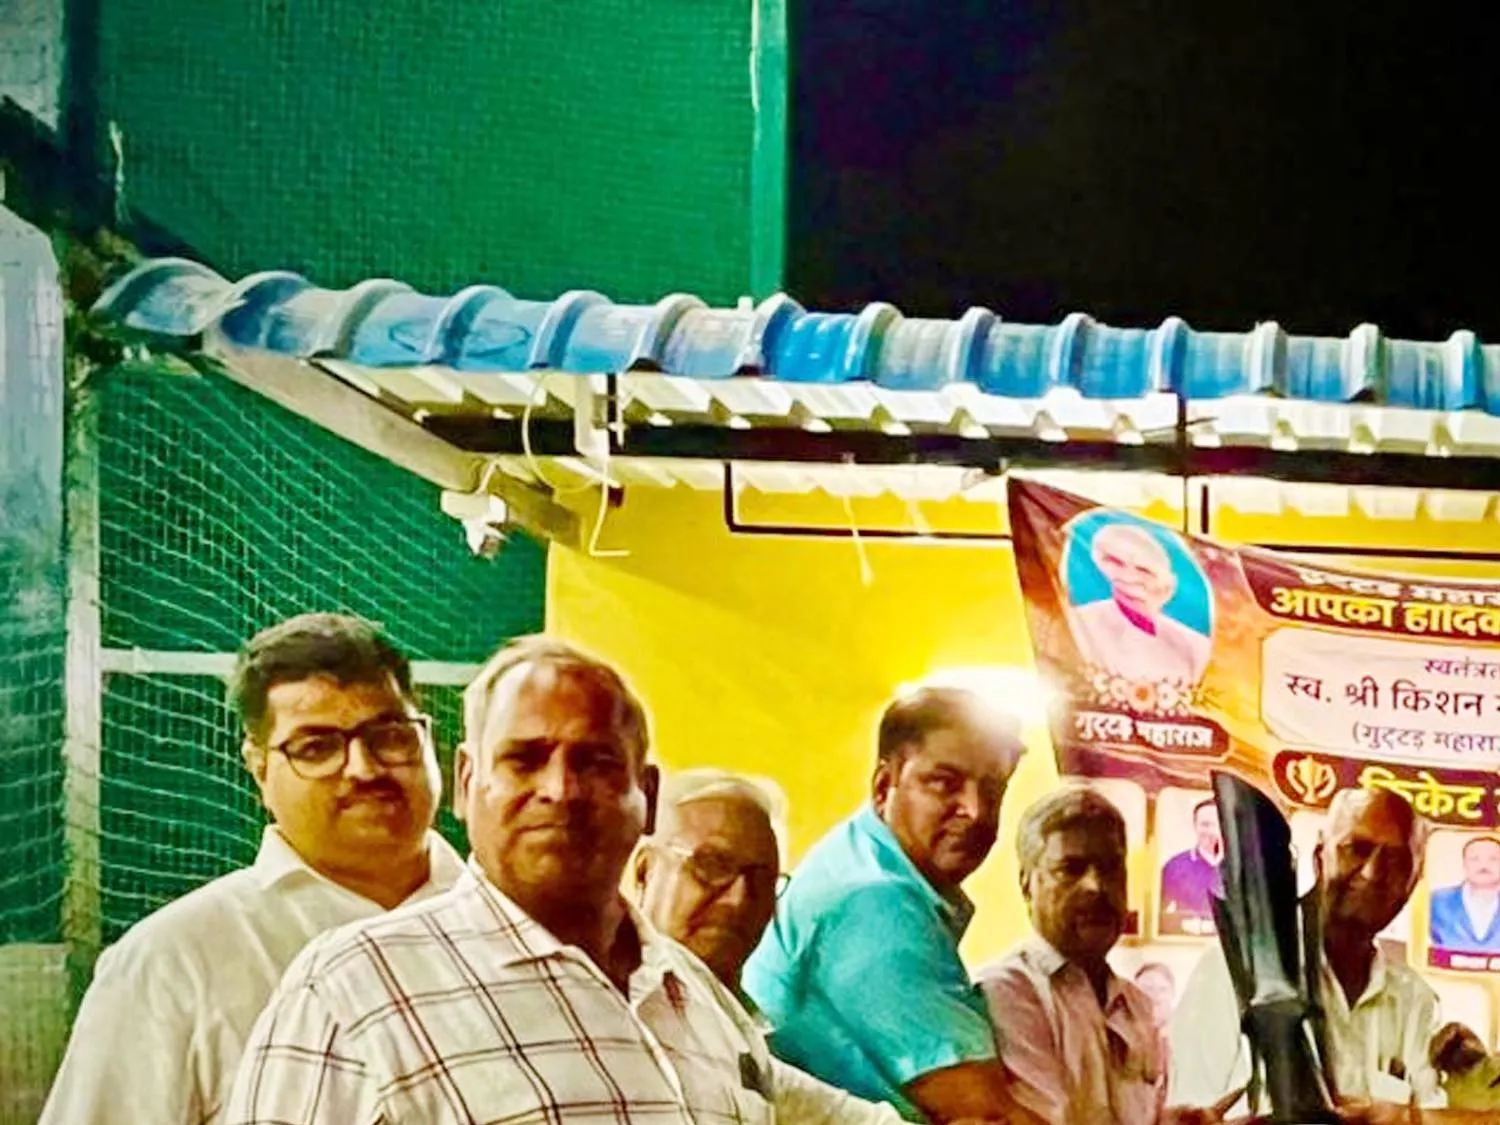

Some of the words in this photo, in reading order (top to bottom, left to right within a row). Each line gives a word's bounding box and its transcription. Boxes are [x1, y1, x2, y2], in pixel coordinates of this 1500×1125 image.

[1270, 586, 1399, 628] आपका
[1284, 672, 1332, 703] स्व.
[1345, 675, 1380, 710] श्री
[1390, 679, 1486, 718] किशन
